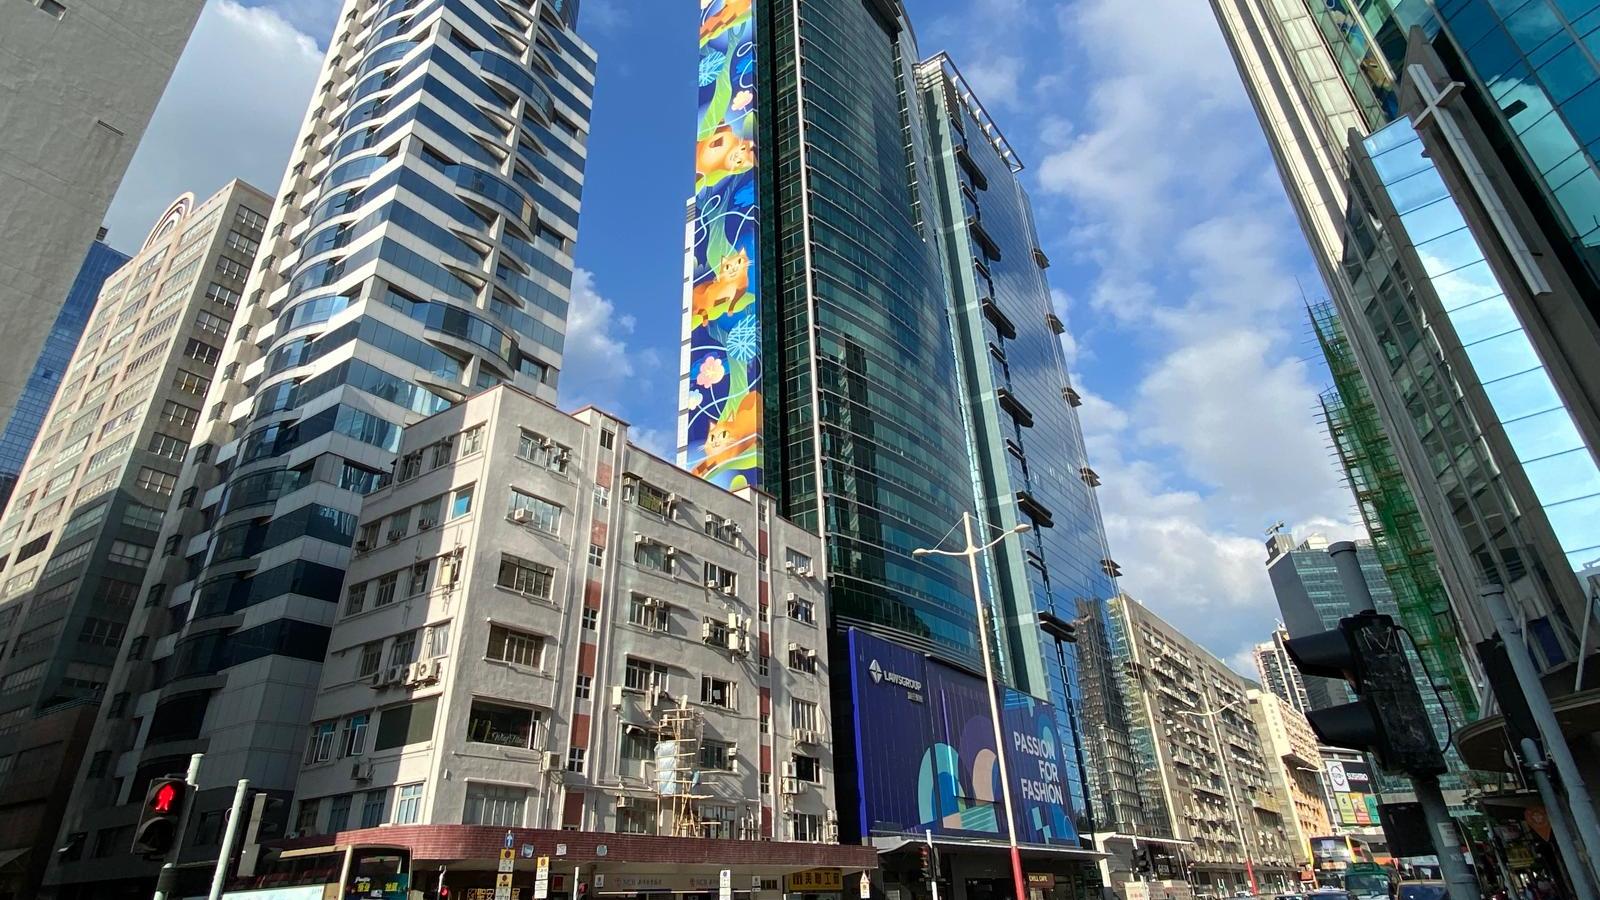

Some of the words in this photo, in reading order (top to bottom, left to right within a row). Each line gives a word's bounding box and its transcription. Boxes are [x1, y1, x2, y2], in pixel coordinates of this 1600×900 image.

[884, 670, 922, 691] LAWSGROUP
[1013, 731, 1056, 760] PASSION
[1039, 760, 1060, 783] FOR
[1020, 778, 1063, 805] FASHION
